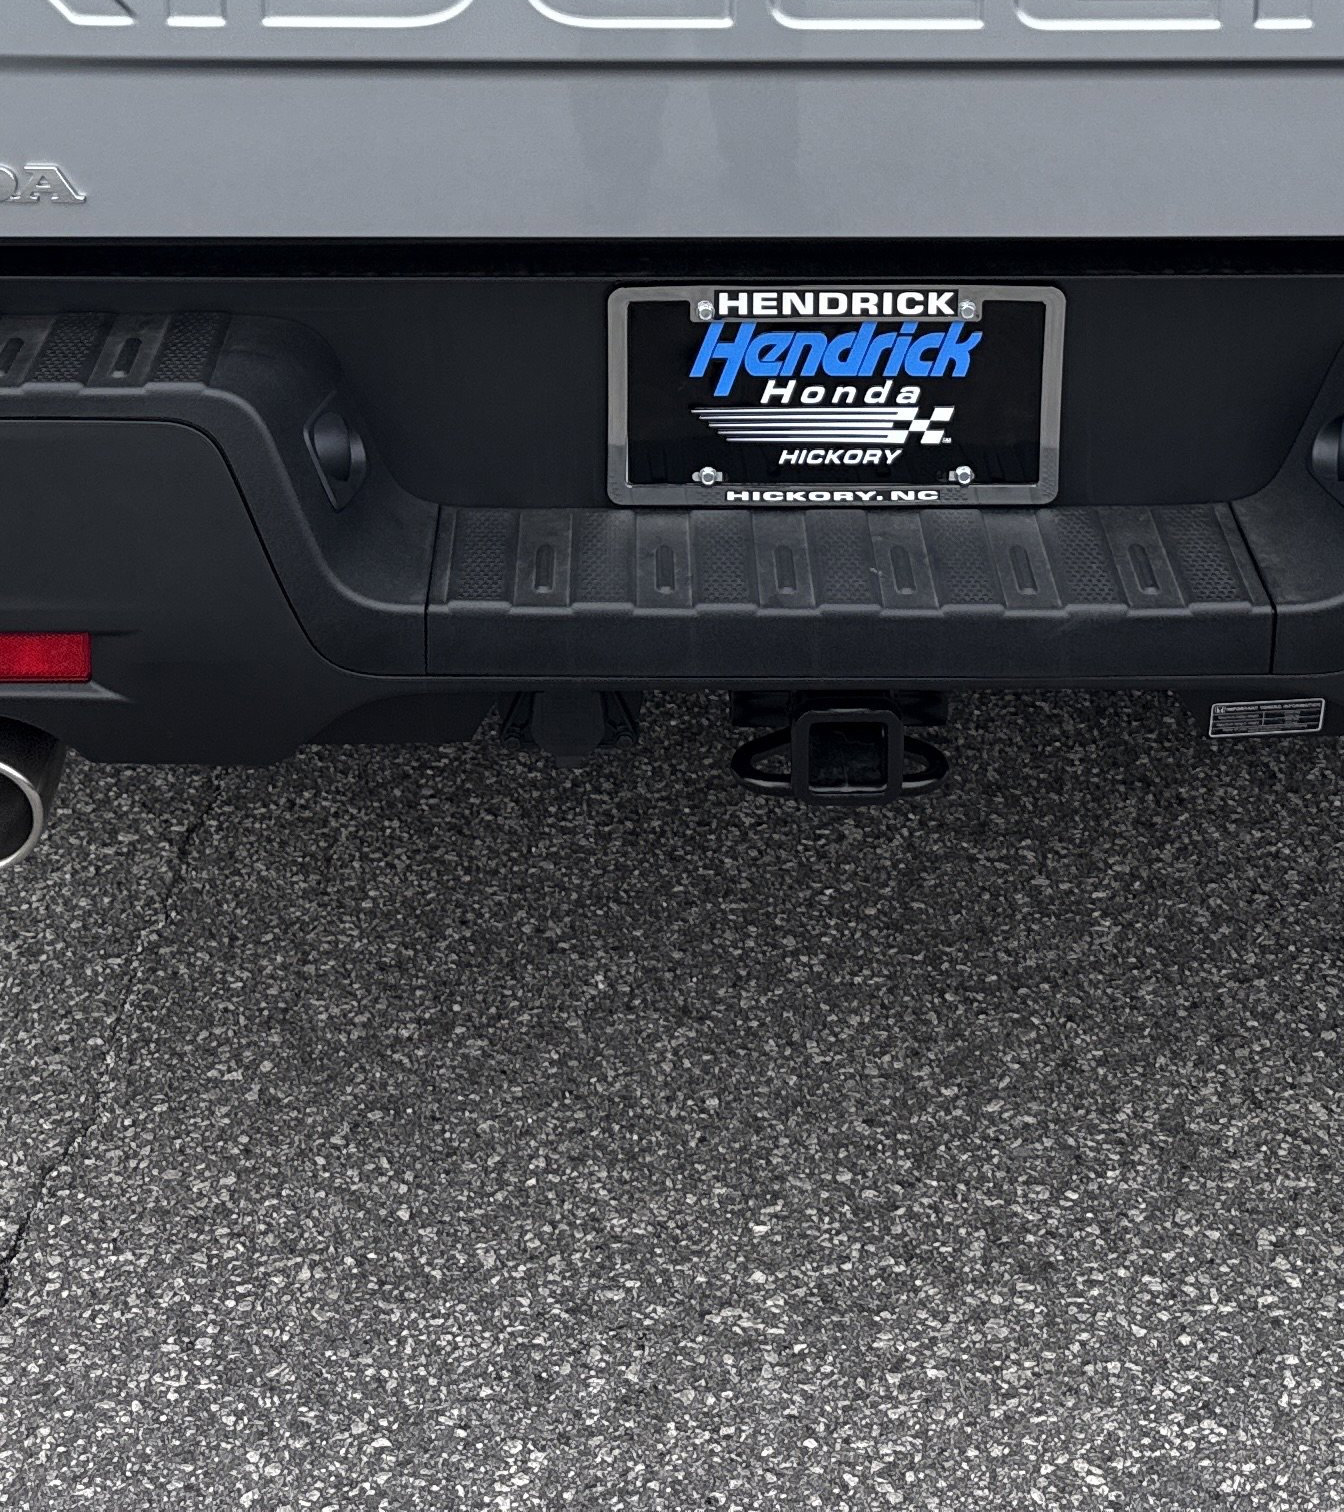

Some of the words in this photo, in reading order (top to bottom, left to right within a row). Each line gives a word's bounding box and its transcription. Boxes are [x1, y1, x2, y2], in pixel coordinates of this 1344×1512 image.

[718, 291, 956, 316] HENDRICK
[689, 320, 984, 397] Hendrick
[760, 378, 921, 404] Honda
[778, 448, 903, 466] HICKORY
[890, 490, 940, 502] NC
